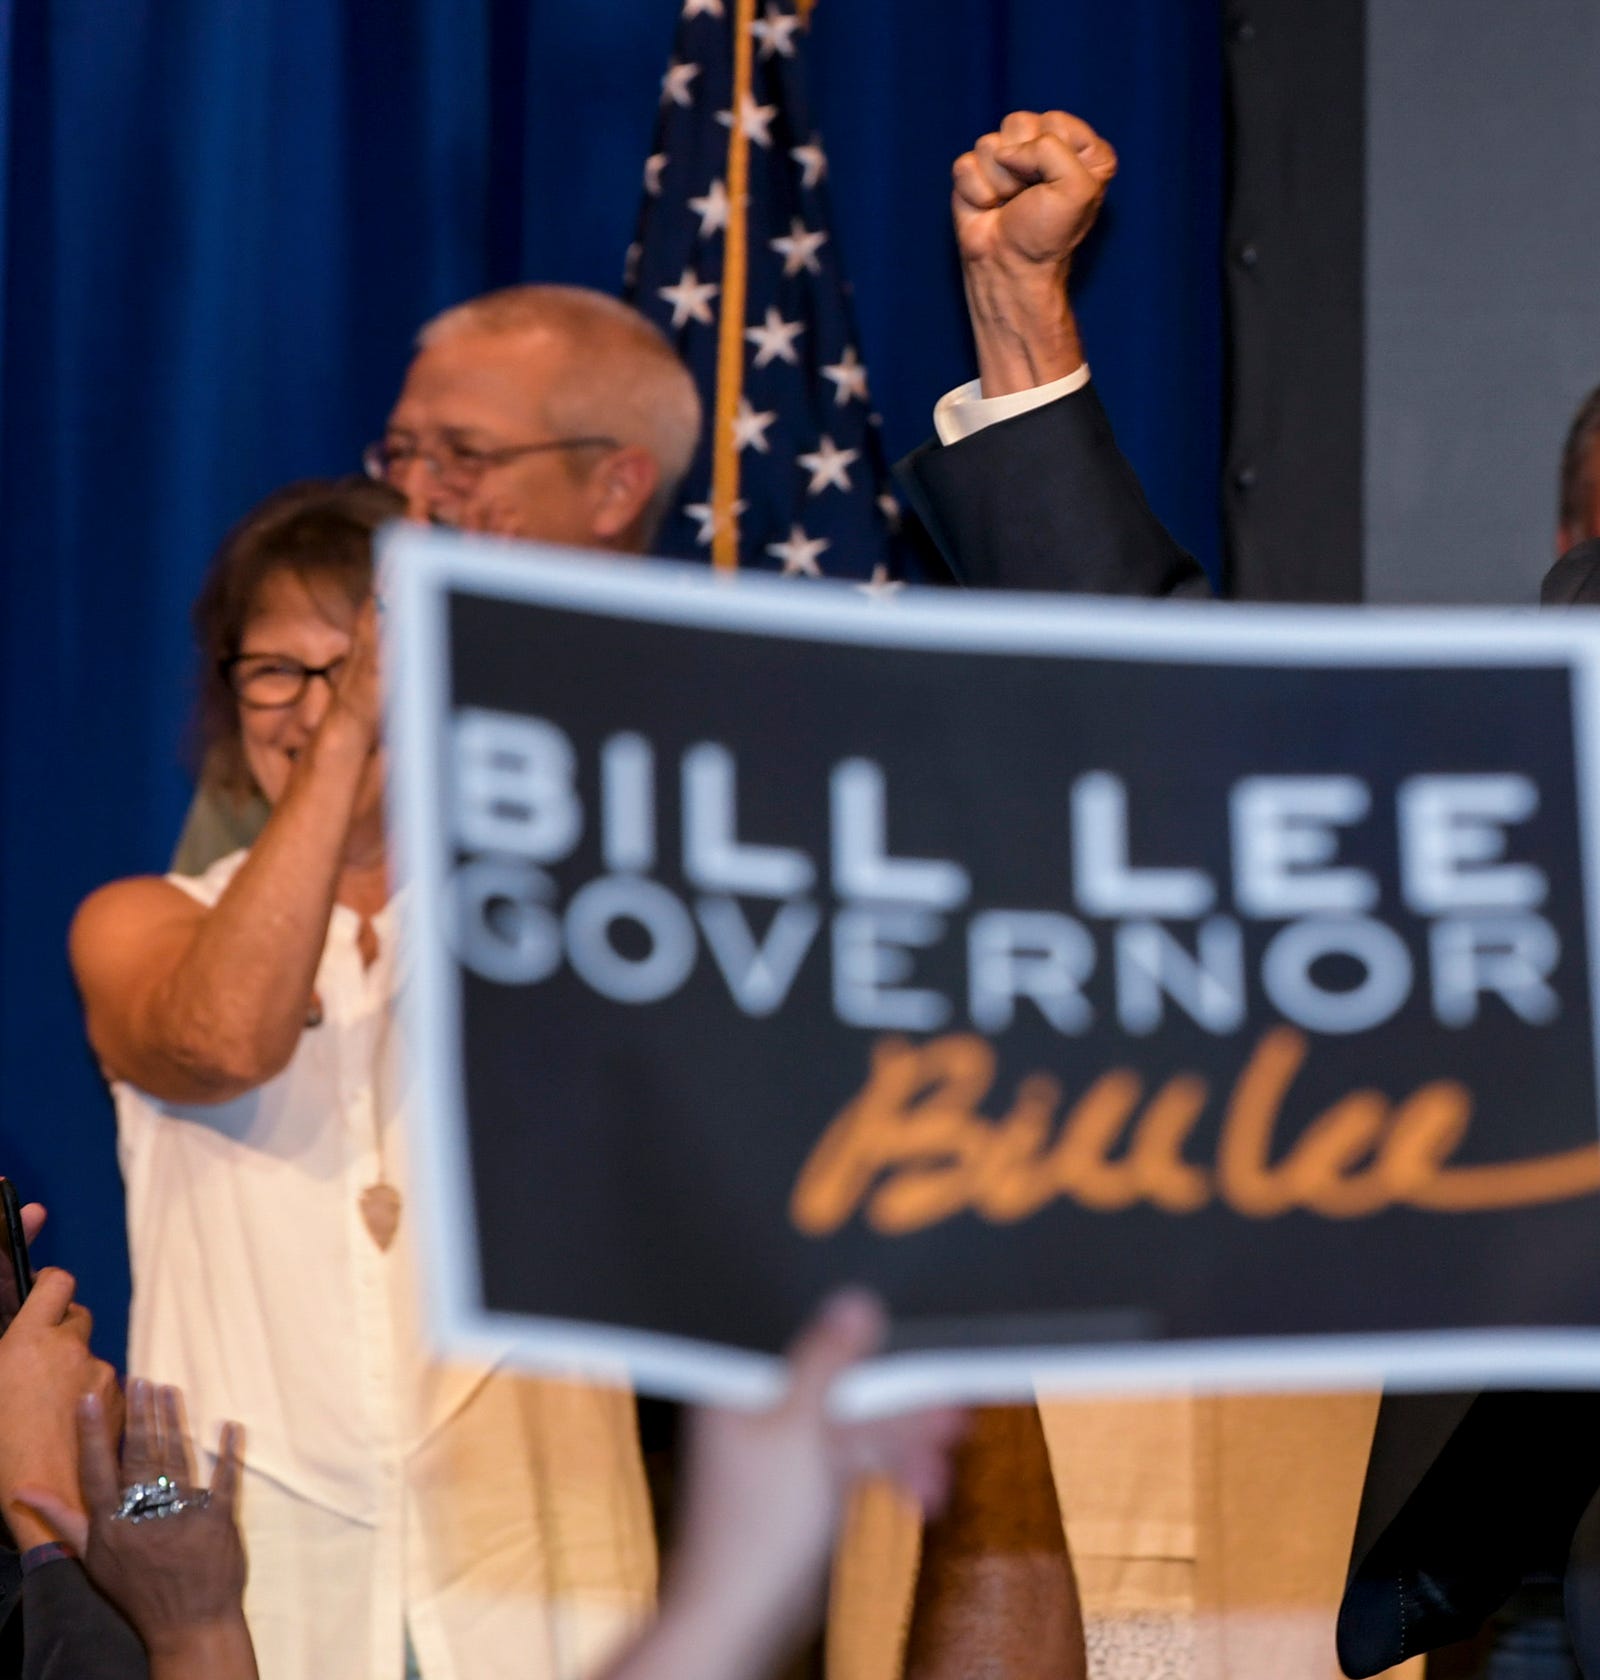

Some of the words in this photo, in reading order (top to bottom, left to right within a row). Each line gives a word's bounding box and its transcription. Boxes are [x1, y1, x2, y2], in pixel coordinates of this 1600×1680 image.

[449, 707, 970, 906] BILL
[1073, 770, 1549, 918] LEE
[452, 856, 1561, 1037] GOVERNOR
